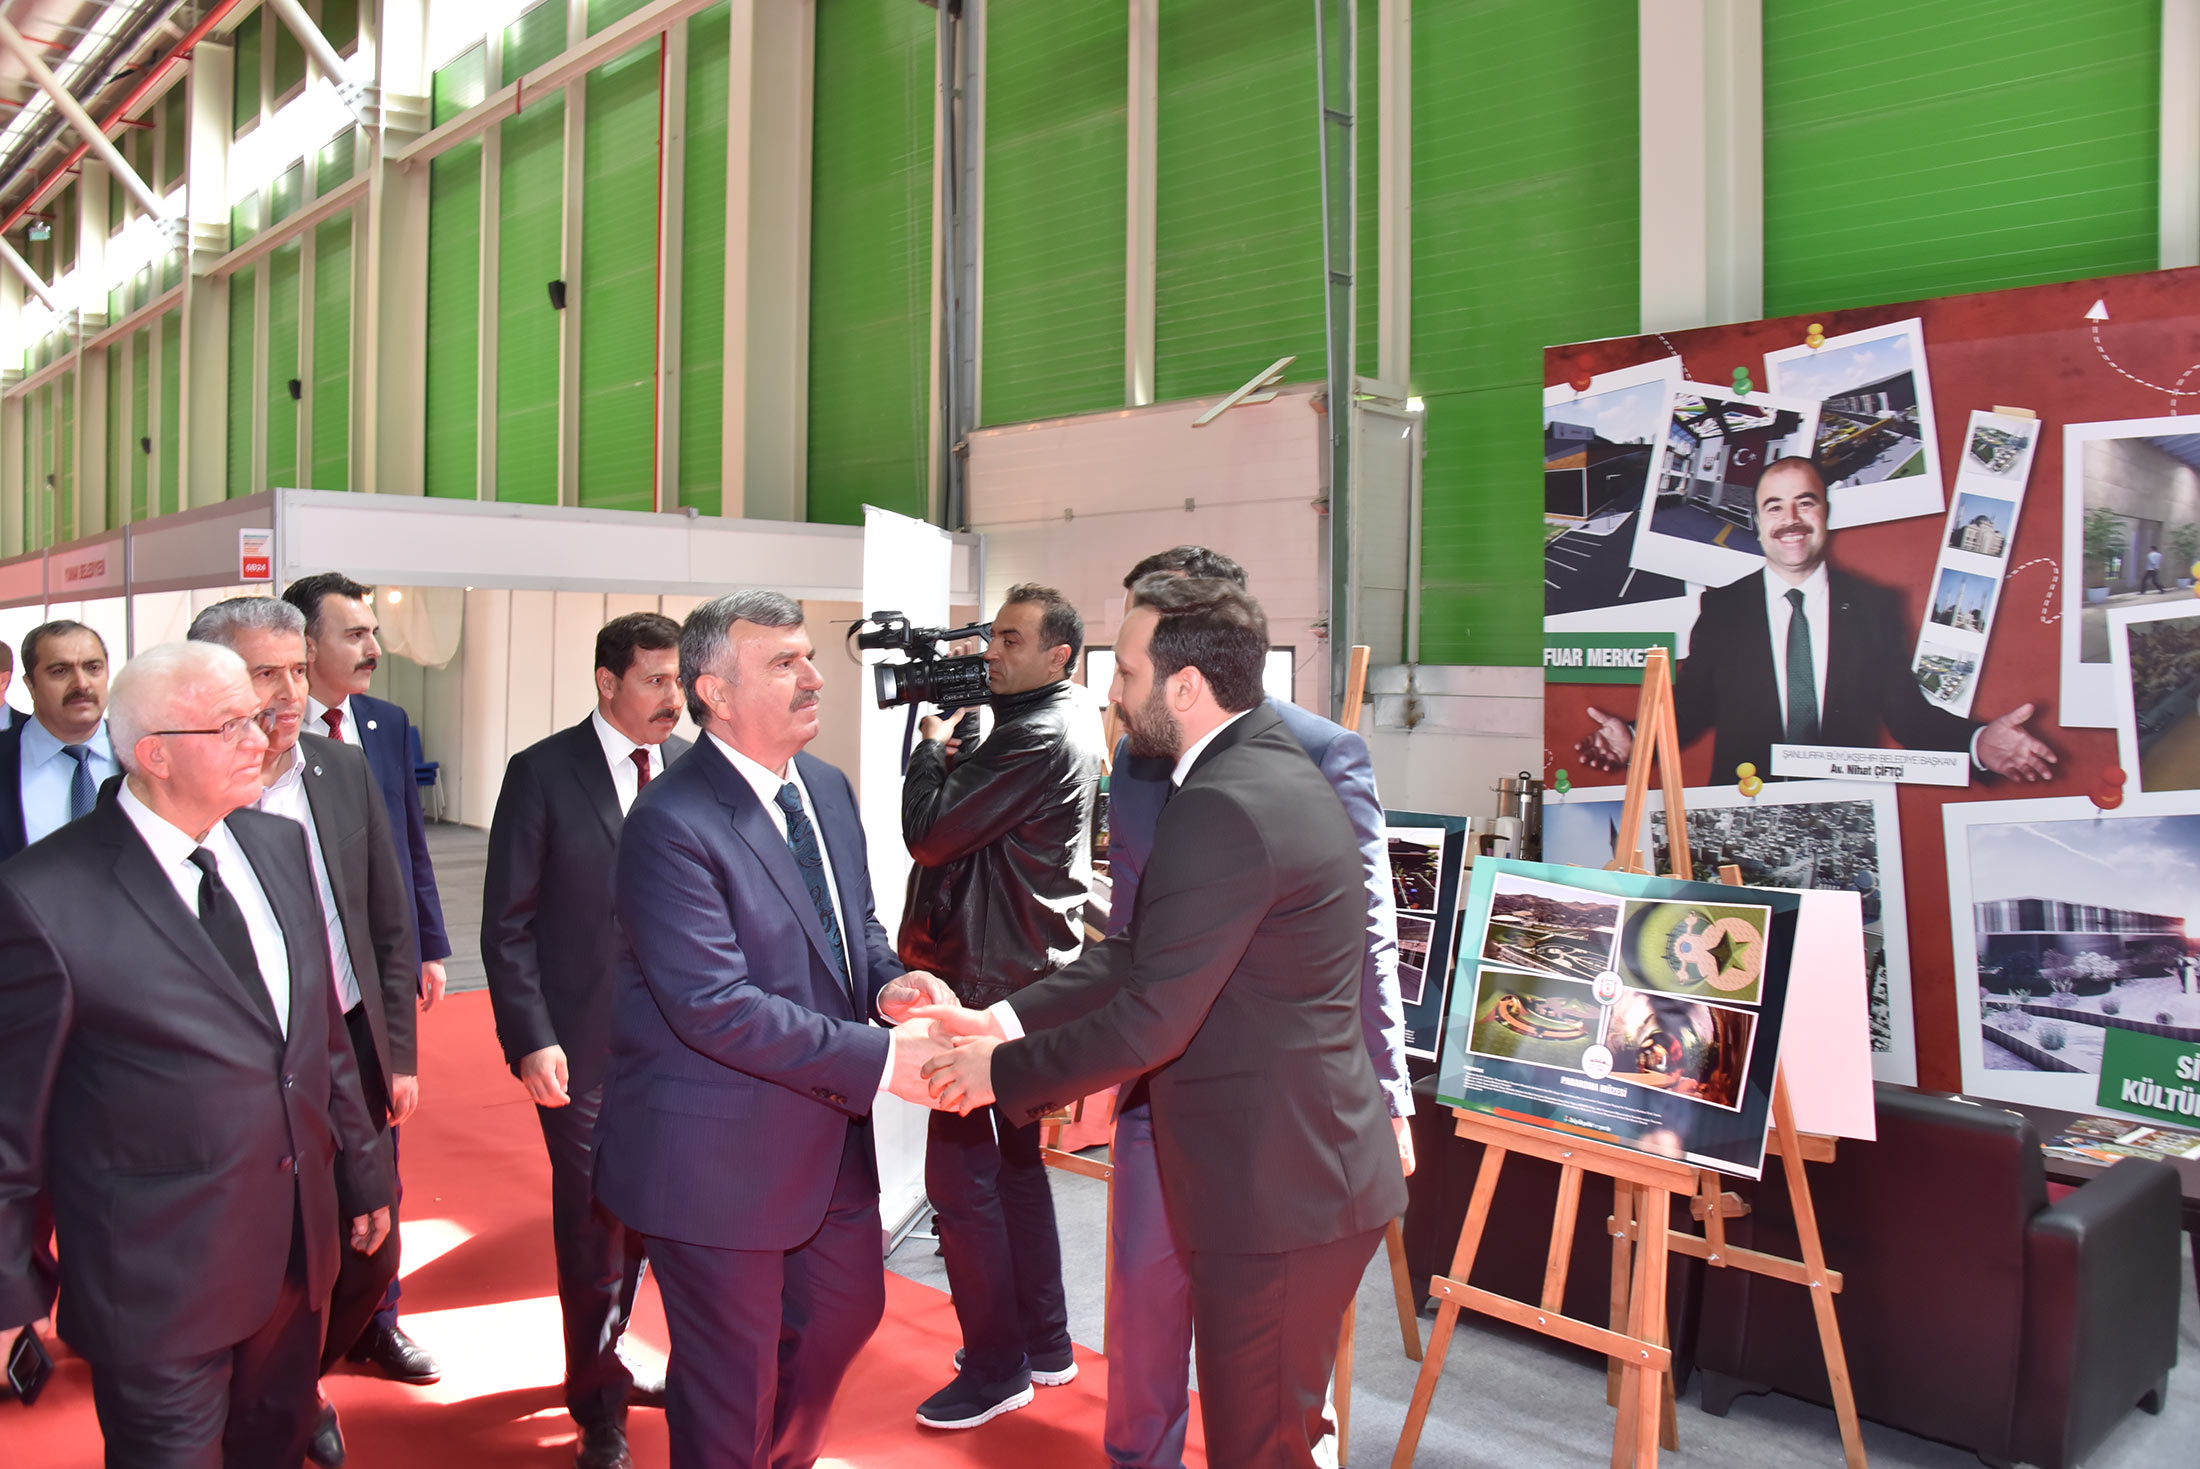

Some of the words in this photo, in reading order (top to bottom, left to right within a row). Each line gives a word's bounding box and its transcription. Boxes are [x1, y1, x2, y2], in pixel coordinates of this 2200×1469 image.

[1543, 647, 1583, 667] FUAR
[1586, 644, 1658, 668] MERKE
[1920, 756, 1958, 767] BAŞKANI
[1830, 763, 1845, 774] Av.
[1847, 764, 1872, 776] Nihat
[1874, 764, 1904, 780] ÇİFTÇİ
